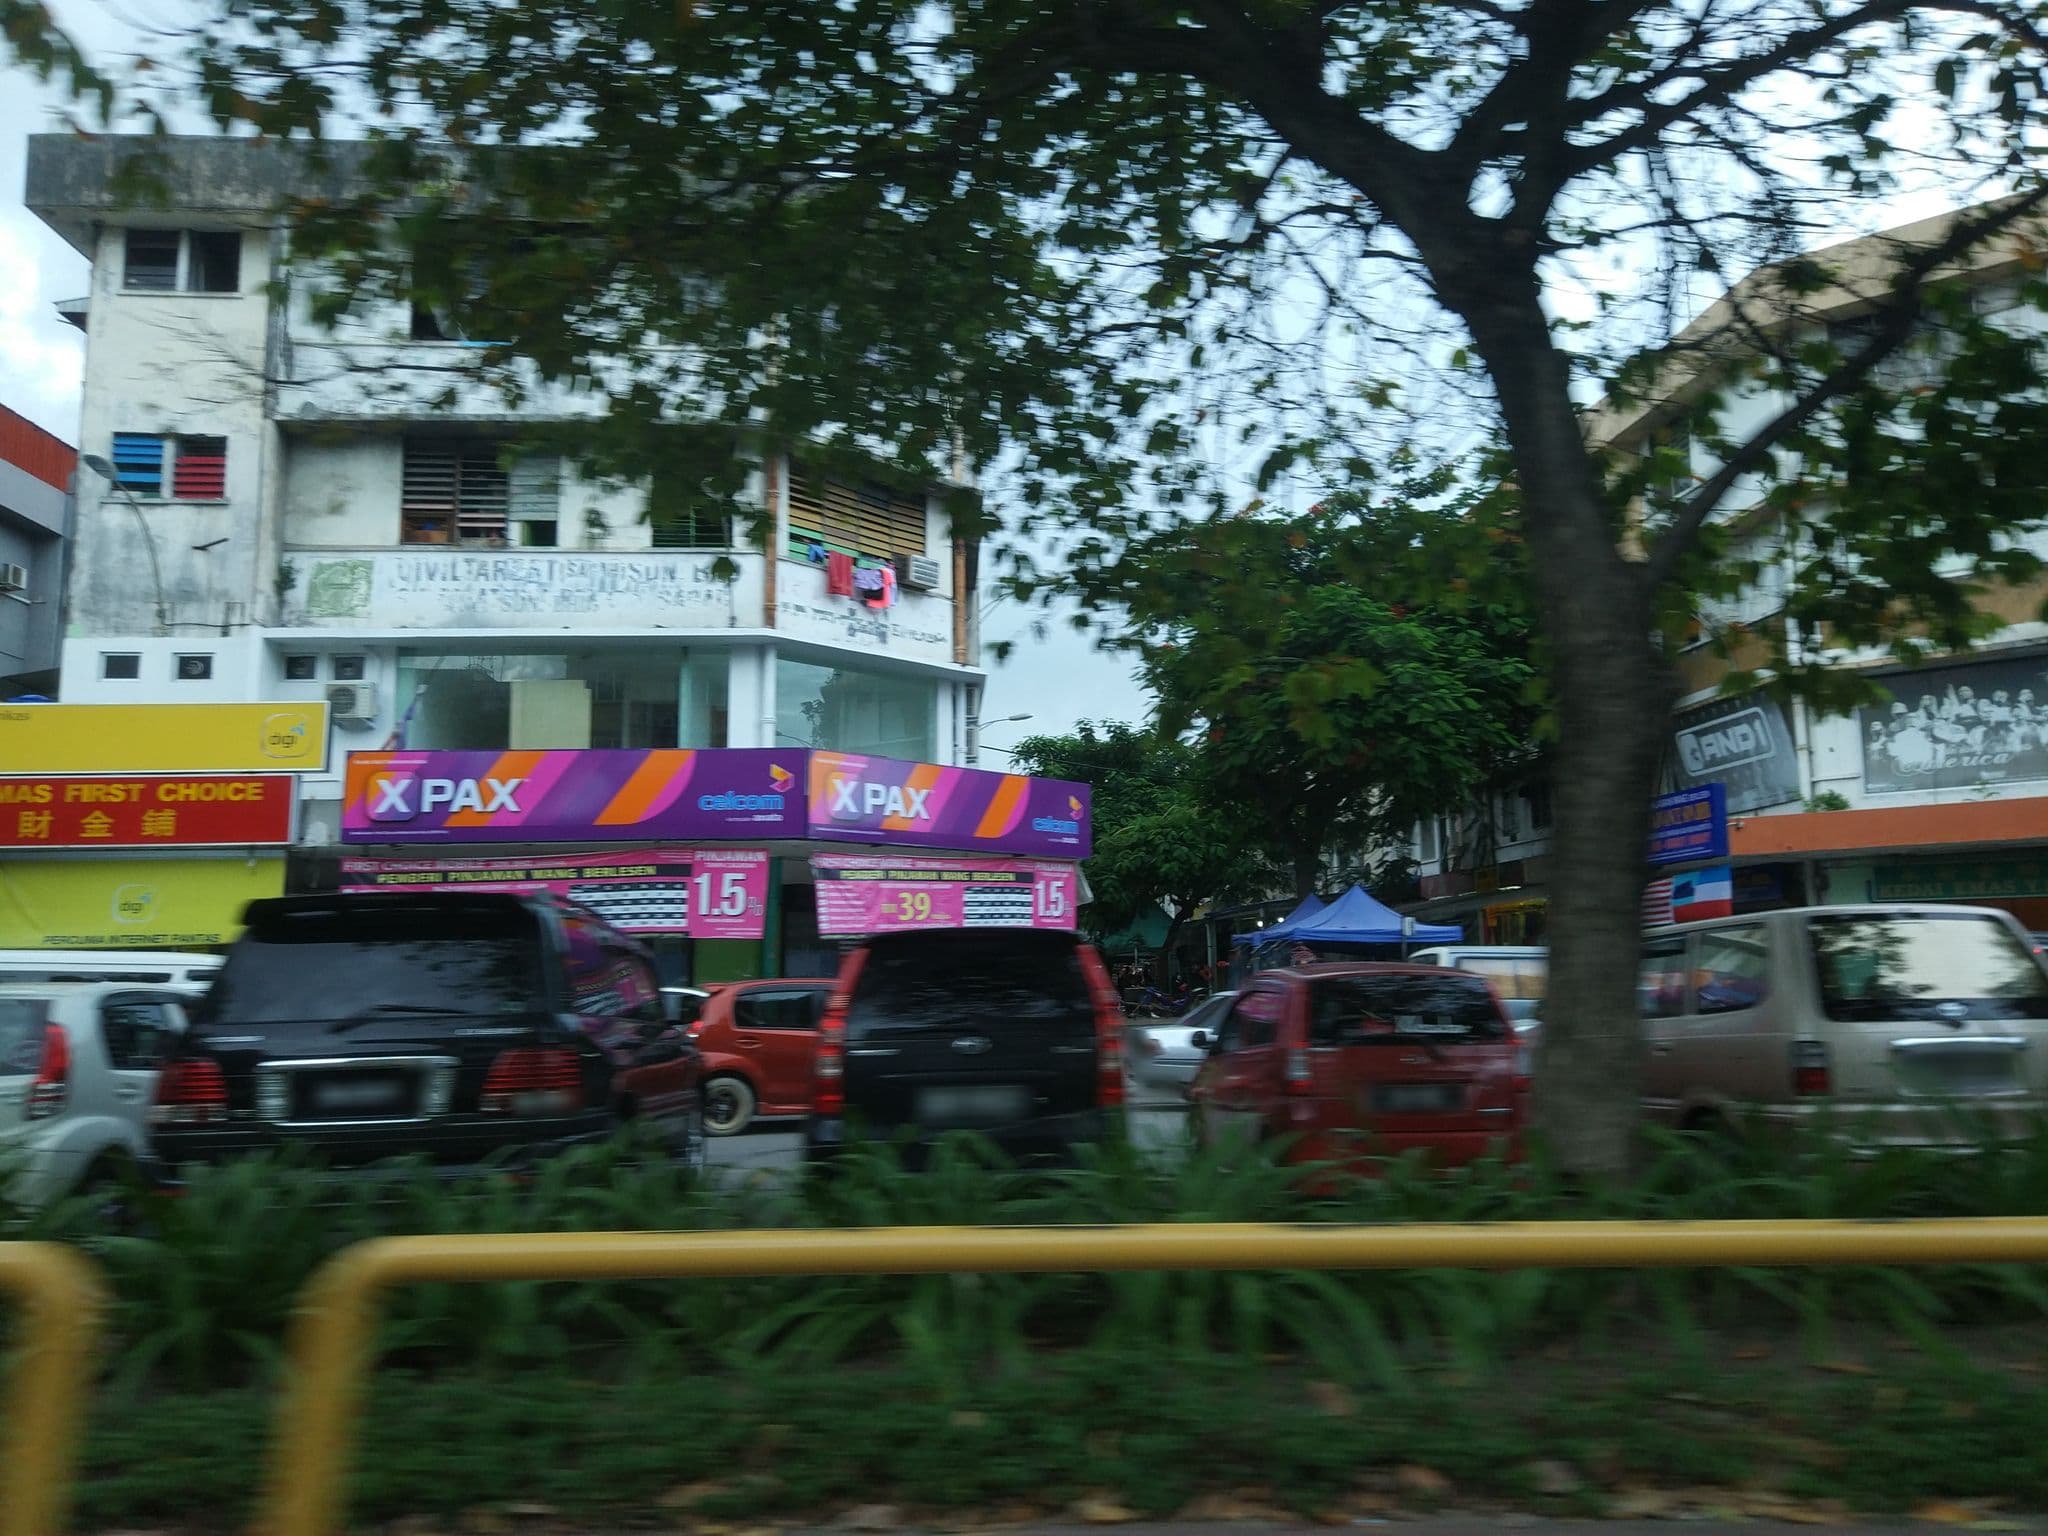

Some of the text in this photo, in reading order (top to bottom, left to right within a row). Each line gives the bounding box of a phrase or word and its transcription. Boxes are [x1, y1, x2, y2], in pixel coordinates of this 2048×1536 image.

[64, 783, 145, 803] FIRST
[156, 781, 265, 802] CHOICE
[697, 790, 785, 811] celcom
[897, 892, 932, 921] 39
